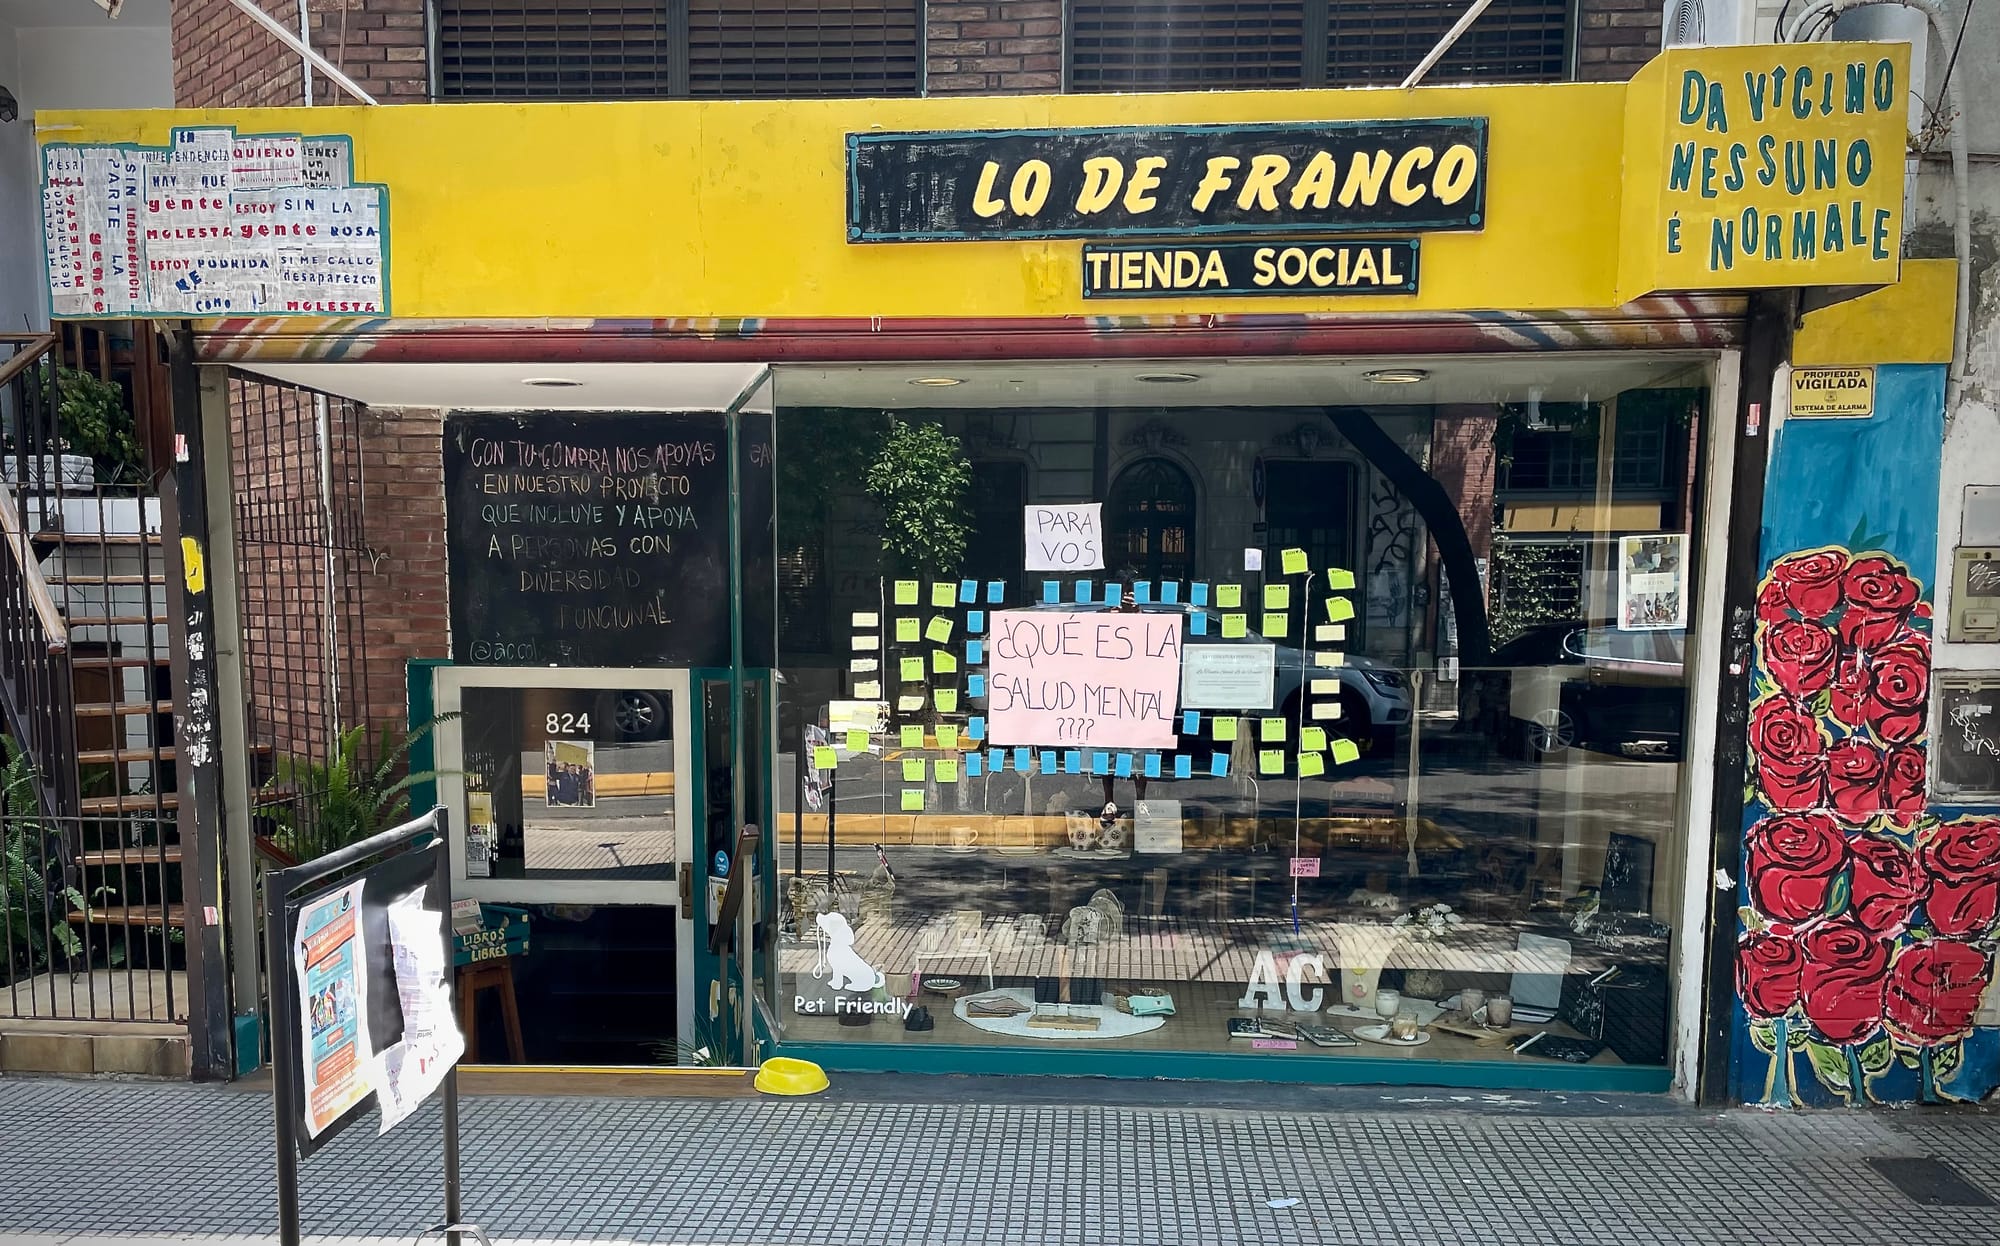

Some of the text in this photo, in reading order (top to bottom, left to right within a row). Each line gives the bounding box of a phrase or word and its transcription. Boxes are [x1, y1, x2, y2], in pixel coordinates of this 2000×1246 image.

[1679, 57, 1895, 134] DA VICINO
[233, 147, 295, 159] QUIERO
[302, 169, 331, 182] ALMA
[1667, 134, 1873, 199] NESSUNO
[125, 163, 137, 197] SIN
[152, 175, 177, 187] HAY
[201, 175, 226, 188] QUE
[971, 142, 1480, 218] LO DE FRANCO
[148, 197, 223, 213] gente
[235, 199, 352, 214] ESTOY SIN LA
[66, 193, 85, 288] MOLESTA
[146, 226, 233, 240] MOLESTA
[240, 222, 376, 239] gente ROSA
[1710, 201, 1892, 271] NORMALE
[89, 232, 104, 312] gente
[111, 254, 124, 276] LA
[150, 258, 269, 271] ESTOY PODRIDA
[281, 256, 374, 265] SI ME CALLO
[1086, 246, 1404, 290] TIENDA SOCIAL
[195, 297, 231, 312] COMO
[287, 301, 375, 312] MOLESTA
[1796, 378, 1868, 390] VIGILADA
[1803, 370, 1861, 378] PROPIEDAD
[471, 438, 716, 477] CON TU COMPRA NOS APOYAS
[483, 473, 690, 501] EN NUESTRO PROYECTO
[482, 503, 699, 530] QUE INCLUYE Y APOYA
[1037, 509, 1094, 535] PARA
[488, 533, 671, 560] A PERSONAS CON
[1041, 540, 1096, 567] VOS
[997, 615, 1178, 669] ¿QUÉ ES LA
[992, 673, 1173, 721] SALUD MENTAL
[546, 712, 591, 734] 824
[1056, 717, 1095, 742] ????
[463, 927, 505, 946] LIBROS
[471, 943, 507, 962] LIBRES
[1238, 950, 1324, 1012] AC
[794, 995, 913, 1020] Pet Friendly
